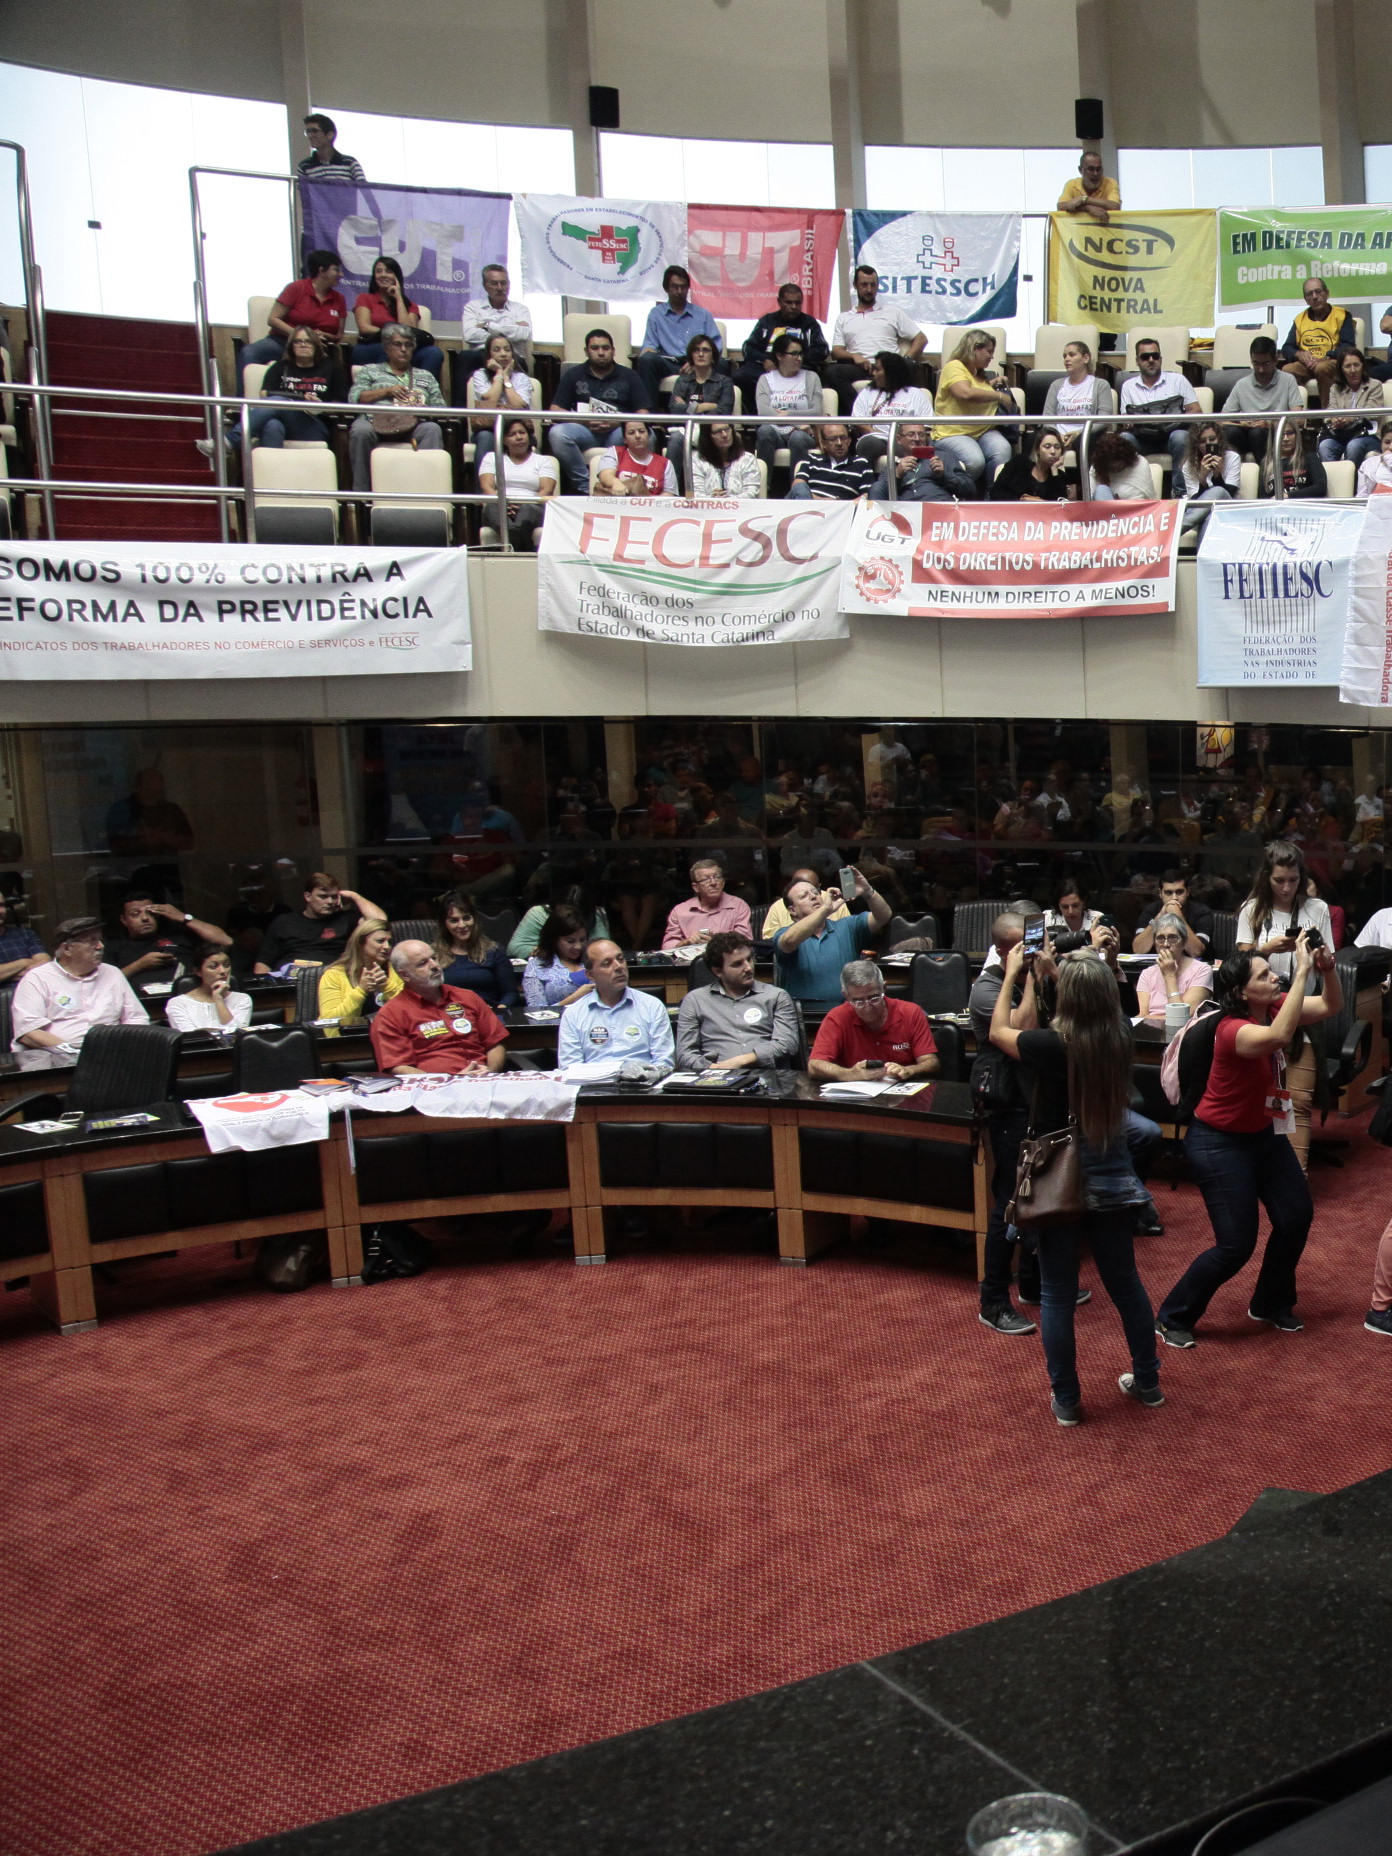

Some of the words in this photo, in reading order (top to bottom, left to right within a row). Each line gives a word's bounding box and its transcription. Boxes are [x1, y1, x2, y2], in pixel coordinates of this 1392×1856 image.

[337, 214, 465, 282] CUT
[1083, 236, 1159, 256] NCST
[1231, 230, 1257, 255] EM
[1262, 228, 1332, 253] DEFESA
[1336, 230, 1366, 251] DA
[687, 229, 801, 288] CUT
[802, 224, 817, 289] BRASIL
[1092, 274, 1146, 294] NOVA
[1237, 261, 1292, 285] Contra
[1296, 264, 1307, 279] a
[1311, 258, 1389, 279] Reforma
[878, 272, 996, 298] SITESSCH
[1077, 294, 1164, 315] CENTRAL
[629, 498, 655, 507] CUT
[672, 500, 740, 510] CONTRACS
[578, 510, 826, 569] FECESC
[865, 529, 913, 545] UGT
[930, 521, 954, 542] EM
[957, 520, 1019, 542] DEFESA
[1023, 521, 1045, 541] DA
[1049, 513, 1155, 541] PREVIDÊNCIA
[1159, 511, 1170, 531] E
[0, 556, 122, 583] SOMOS
[134, 561, 227, 585] 100%
[239, 561, 374, 585] CONTRA
[384, 560, 407, 583] A
[922, 550, 954, 569] DOS
[959, 551, 1034, 571] DIREITOS
[1039, 545, 1164, 570] TRABALHISTAS!
[1221, 559, 1334, 600] FETIESC
[158, 599, 205, 623] DA
[217, 591, 434, 623] PREVIDÊNCIA
[578, 581, 660, 611] Federação
[665, 596, 695, 610] dos
[927, 589, 1000, 604] NENHUM
[1005, 588, 1071, 604] DIREITO
[1075, 588, 1086, 602] A
[1090, 584, 1156, 602] MENOS!
[576, 598, 689, 628] Trabalhadores
[694, 615, 716, 628] no
[721, 608, 796, 627] Comércio
[801, 607, 821, 620] no
[72, 641, 99, 651] DOS
[102, 641, 211, 651] TRABALHADORES
[214, 641, 231, 650] NO
[234, 637, 295, 650] COMÉRCIO
[299, 639, 306, 649] E
[309, 638, 366, 650] SERVIÇOS
[368, 640, 375, 648] e
[379, 635, 421, 648] FECESC
[577, 616, 631, 640] Estado
[636, 623, 657, 640] de
[661, 628, 706, 645] Santa
[710, 628, 776, 645] Catarina
[1242, 635, 1295, 645] FEDERAÇÃO
[1299, 635, 1317, 644] DOS
[1242, 647, 1317, 656] TRABALHADORES
[1242, 659, 1260, 668] NAS
[1265, 656, 1317, 668] INDÚSTRIAS
[1242, 671, 1257, 680] DO
[1262, 671, 1299, 680] ESTADO
[1304, 670, 1317, 680] DE
